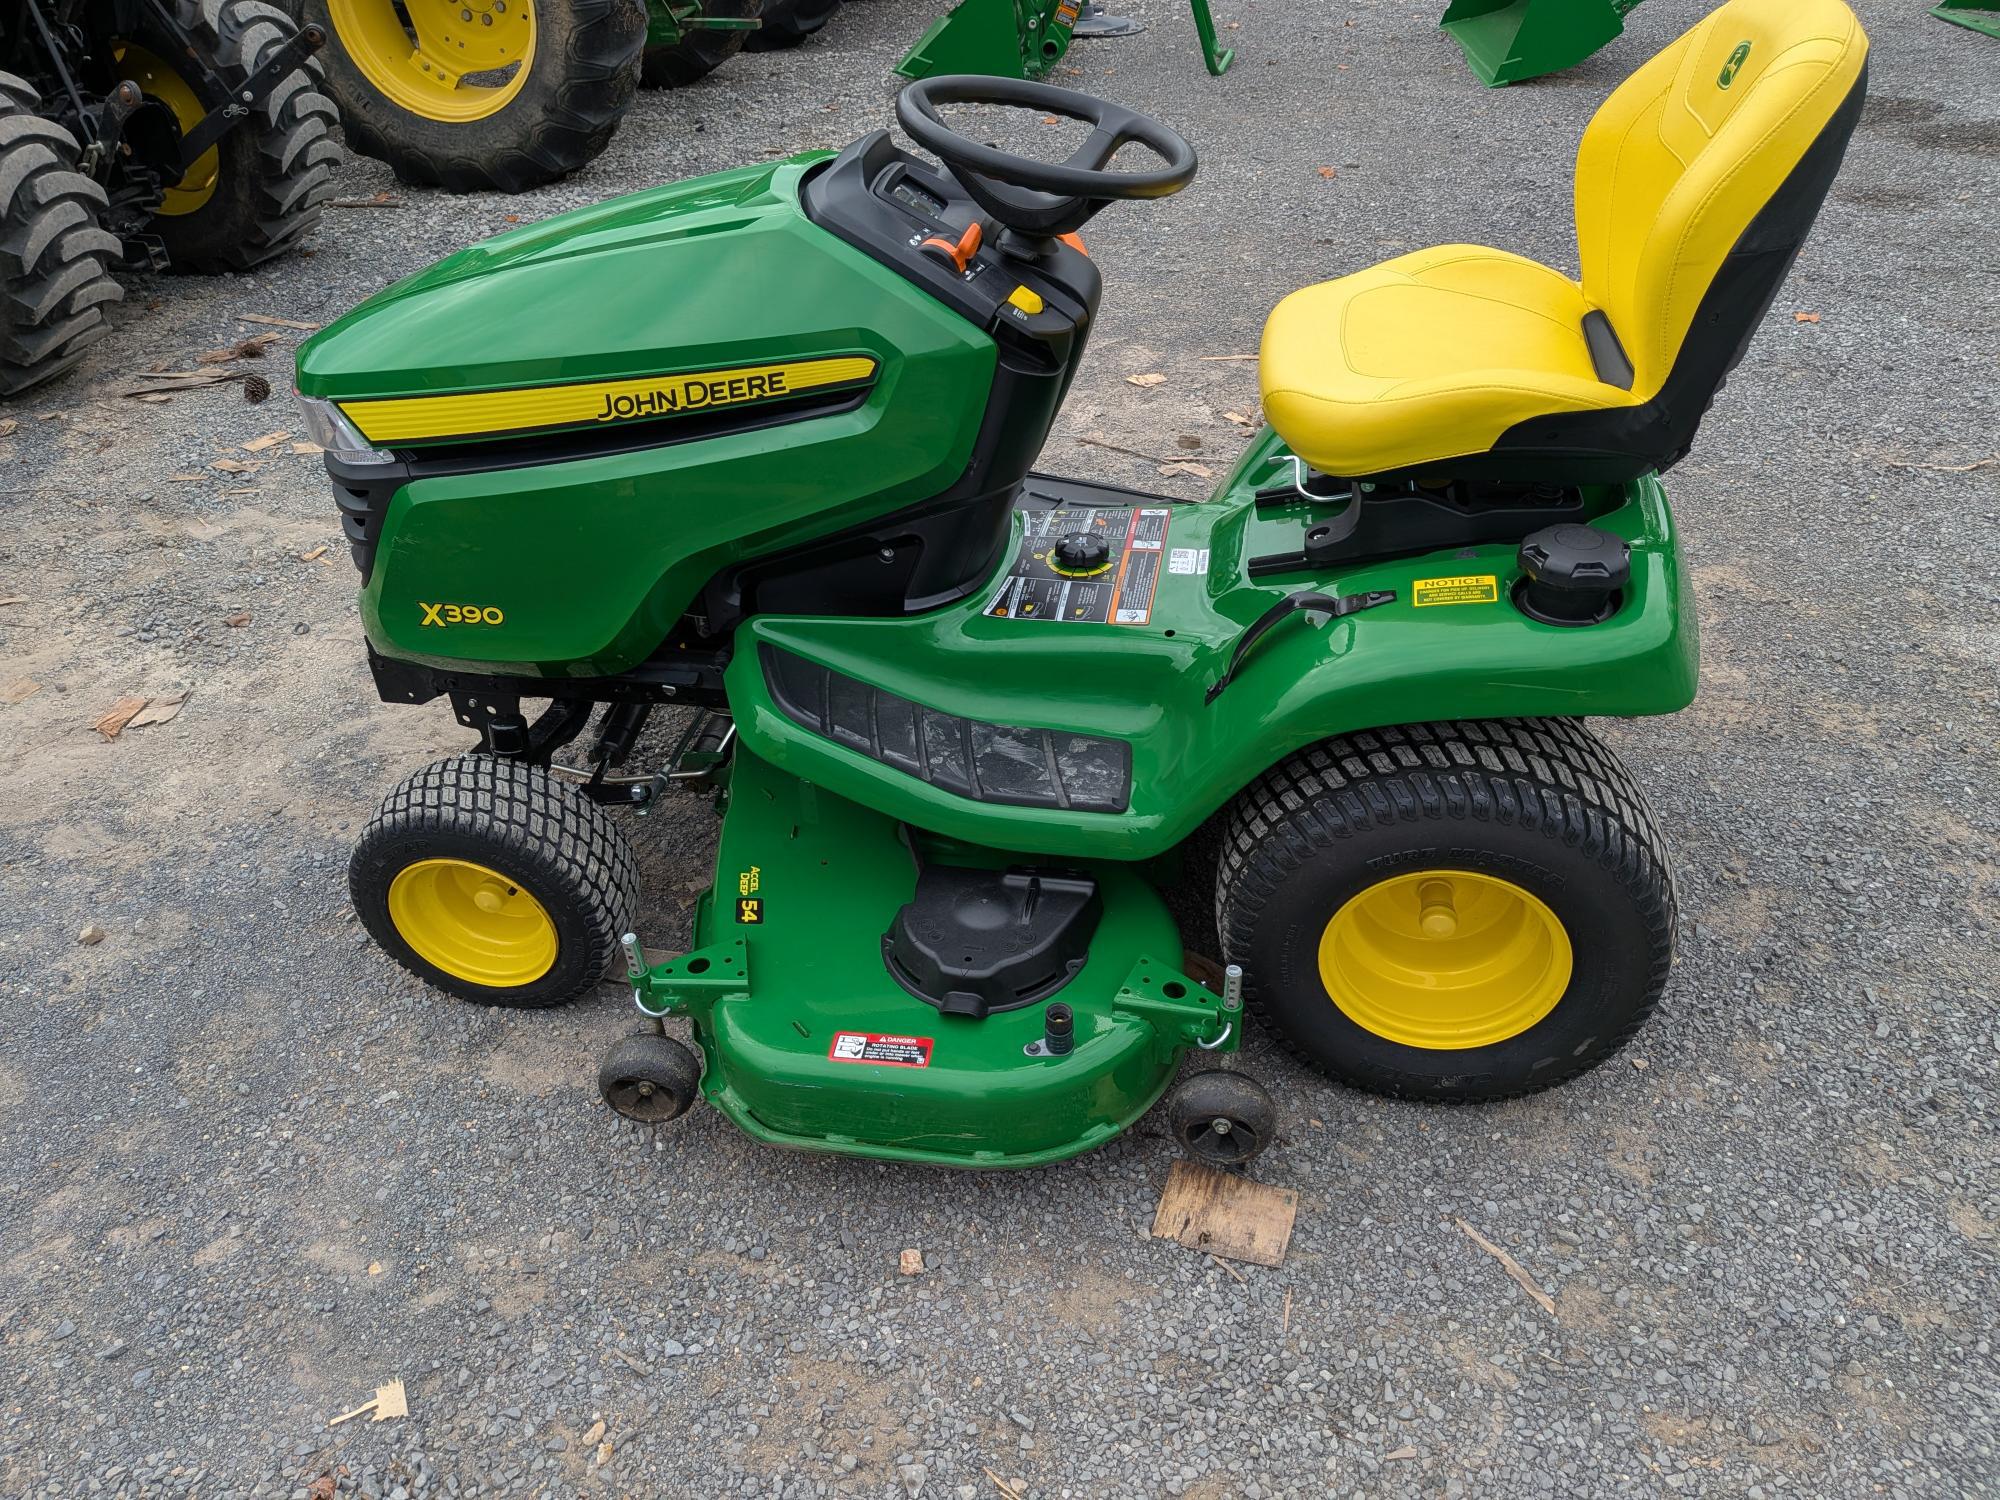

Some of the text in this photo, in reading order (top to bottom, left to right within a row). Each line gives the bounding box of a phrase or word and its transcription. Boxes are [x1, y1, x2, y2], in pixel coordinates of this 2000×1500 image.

[597, 371, 787, 419] JOHN DEERE
[1423, 577, 1486, 588] NOTICE
[418, 601, 504, 627] X390
[740, 872, 750, 896] DEEP
[750, 865, 761, 893] ACCEL
[741, 900, 758, 922] 54
[887, 1036, 917, 1044] DANGER
